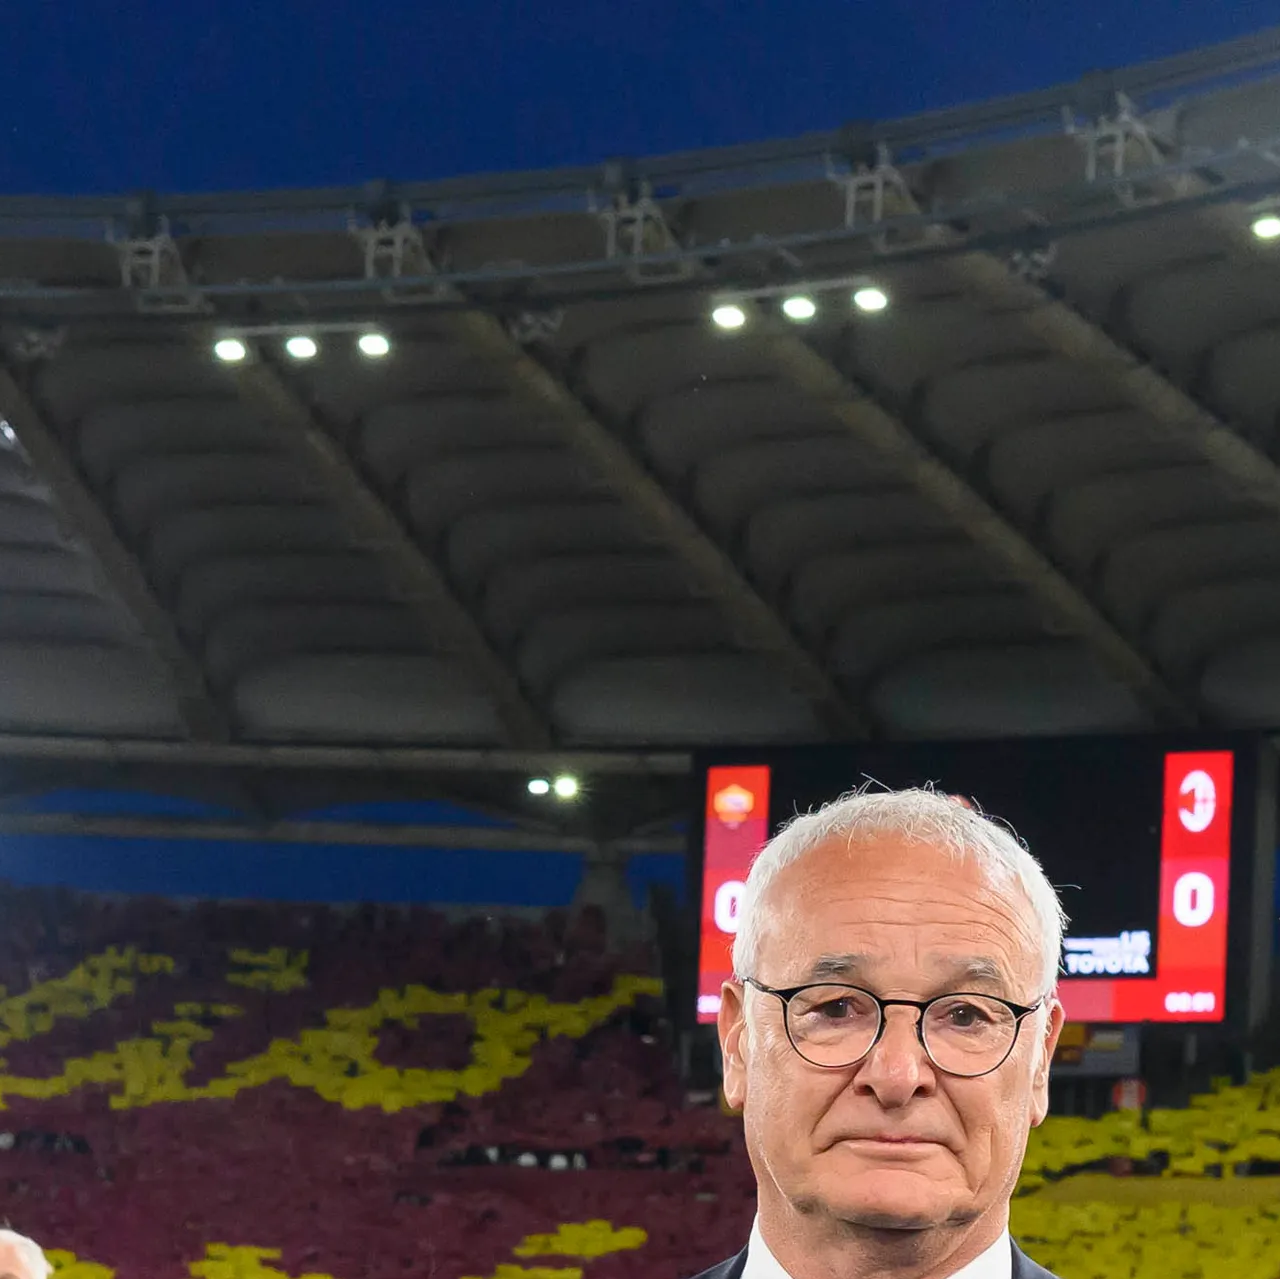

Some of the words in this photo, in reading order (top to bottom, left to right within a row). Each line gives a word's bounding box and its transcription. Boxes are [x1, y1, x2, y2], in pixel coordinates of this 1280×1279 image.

[714, 880, 747, 933] 0
[1173, 871, 1215, 927] 0
[1066, 953, 1150, 974] TOYOTA
